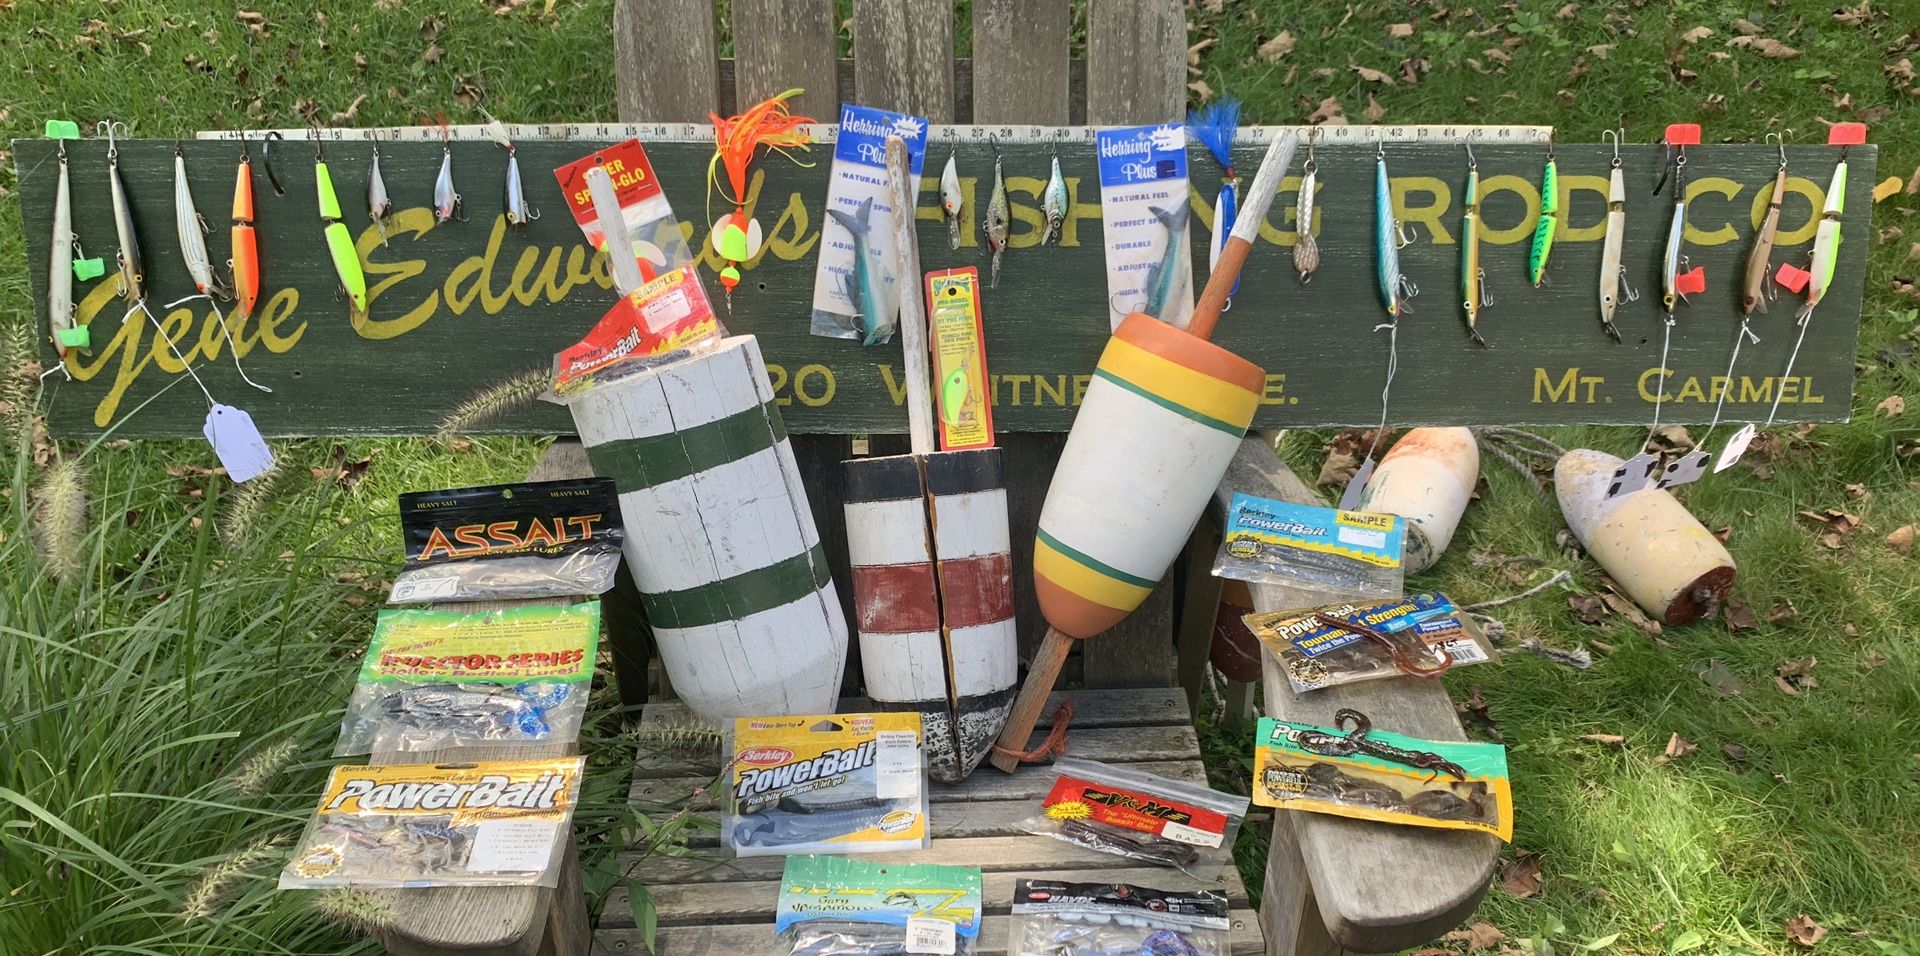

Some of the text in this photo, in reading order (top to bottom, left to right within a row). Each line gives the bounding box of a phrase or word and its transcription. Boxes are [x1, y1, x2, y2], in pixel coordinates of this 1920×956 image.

[537, 126, 550, 136] 12
[567, 126, 580, 136] 13
[596, 126, 609, 136] 14
[625, 126, 638, 136] 15
[654, 126, 667, 136] 16
[683, 126, 696, 136] 17
[842, 109, 896, 149] Herring
[857, 142, 886, 165] Plu
[1101, 136, 1152, 164] Herring
[842, 172, 881, 186] NATURAL
[1121, 162, 1157, 181] Plus
[574, 167, 646, 206] SPN-GLO
[1112, 191, 1169, 203] NATURAL FEEL
[1113, 219, 1146, 228] PERFECT
[1115, 240, 1152, 250] DURABLE
[66, 271, 309, 428] Gene
[1388, 174, 1617, 245] ROD
[1637, 367, 1825, 404] CARMEL
[416, 488, 591, 510] HEAVY SALT HEAVY SALT
[1237, 514, 1328, 537] PowerBait
[1343, 512, 1388, 528] SAMPLE
[416, 513, 603, 562] ASSALT
[1307, 642, 1333, 655] Twice
[1331, 638, 1346, 649] the
[506, 648, 585, 669] SERIES
[744, 749, 789, 762] Berkley
[736, 738, 878, 800] PowerBait
[326, 773, 568, 811] PowerBait
[747, 795, 764, 806] Fish
[765, 793, 781, 802] bite
[781, 787, 797, 798] and
[797, 781, 819, 795] won't
[819, 778, 832, 789] let
[1103, 808, 1118, 817] The
